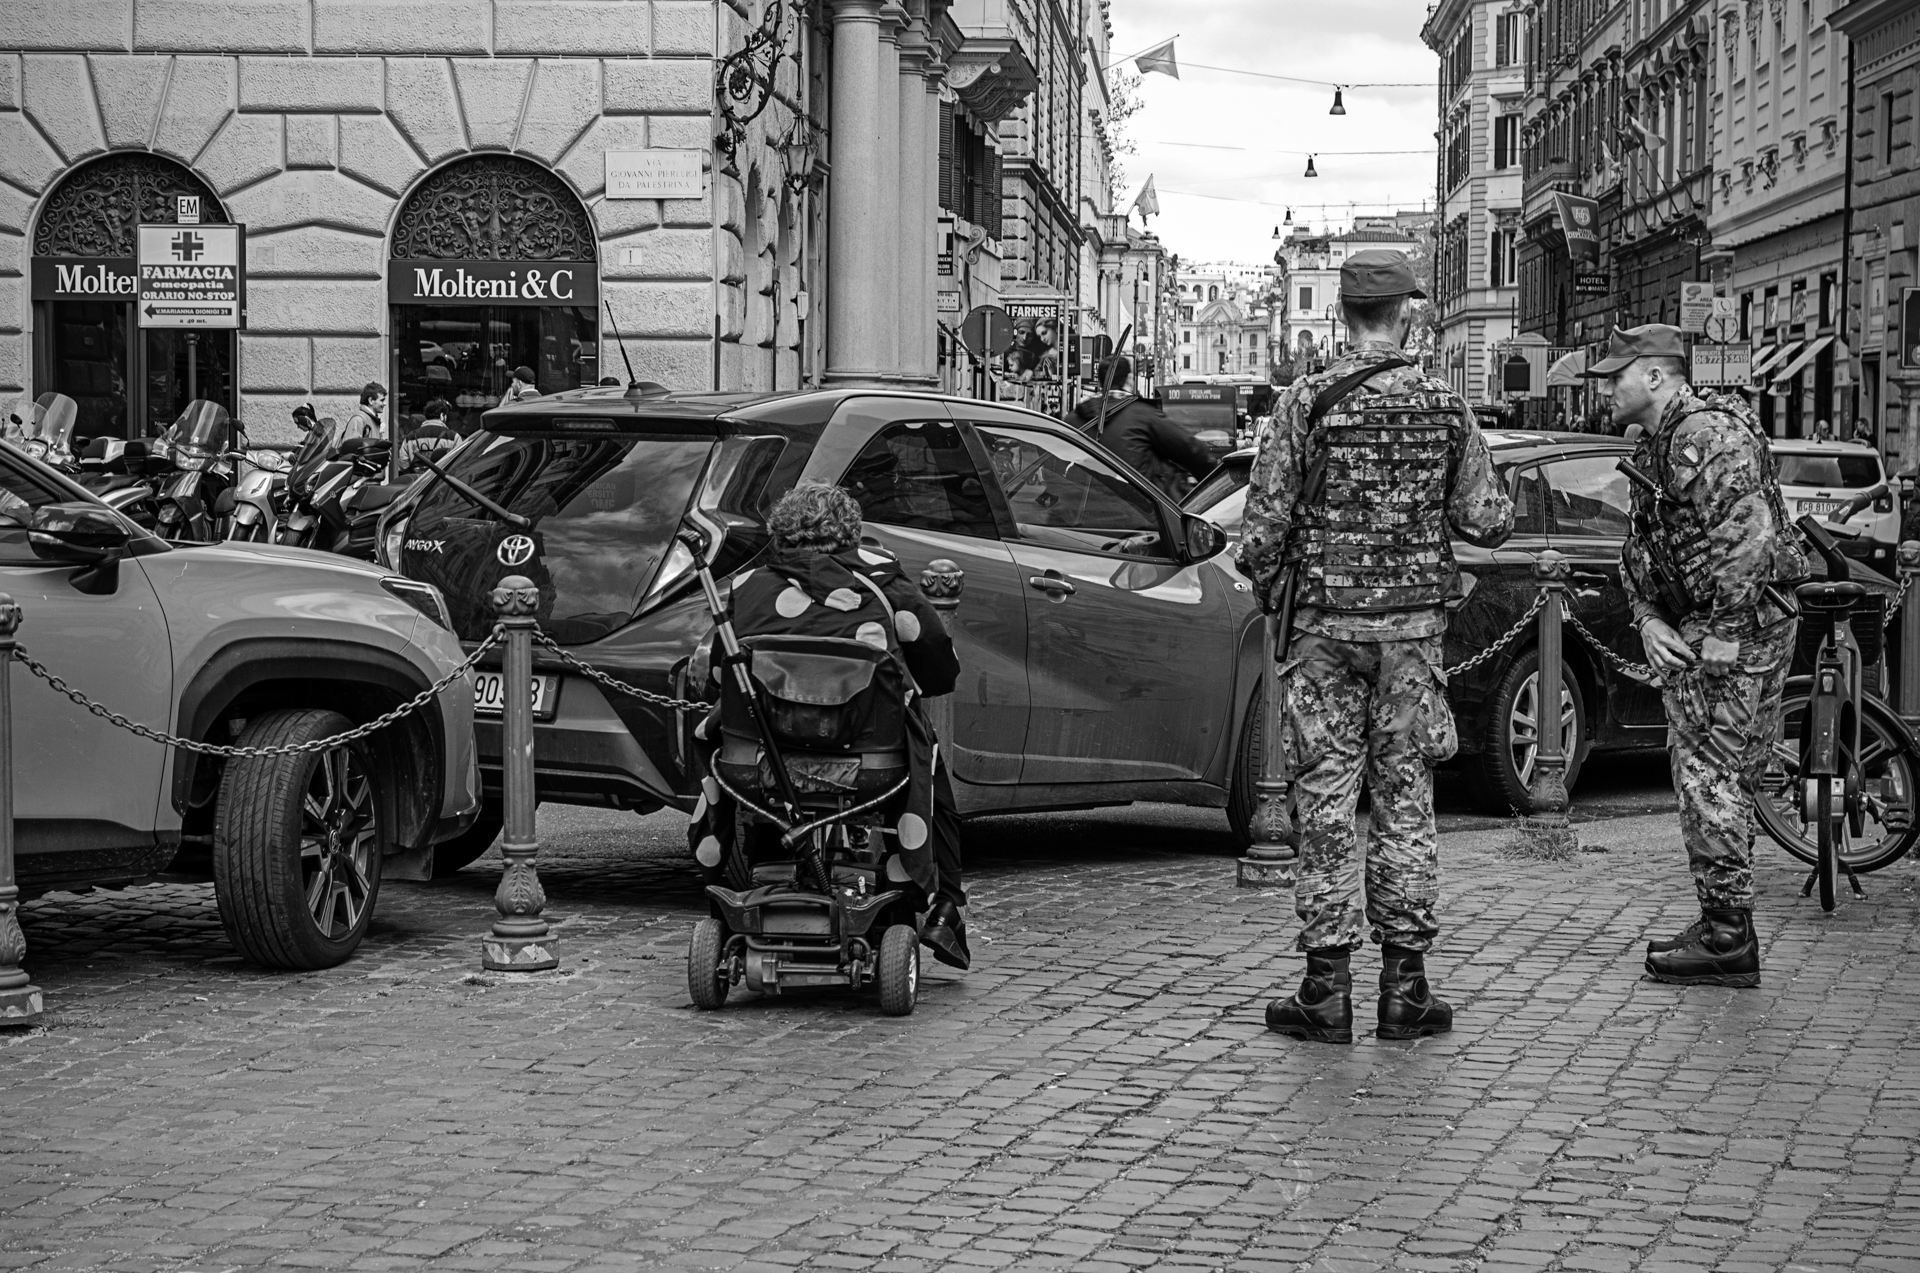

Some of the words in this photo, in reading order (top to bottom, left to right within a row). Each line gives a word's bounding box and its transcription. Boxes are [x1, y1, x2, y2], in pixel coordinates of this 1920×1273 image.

[610, 170, 652, 178] GIOVANNI
[657, 170, 697, 178] PIERLUIGI
[636, 181, 690, 189] PALESTRINA
[179, 199, 198, 214] EM
[142, 266, 234, 279] FARMACIA
[152, 281, 224, 290] omeopatia
[142, 291, 185, 300] ORARIO
[187, 291, 235, 300] NO-STOP
[1012, 306, 1057, 317] FARNESE
[1696, 356, 1706, 364] 06
[1730, 355, 1748, 363] 3419
[1168, 389, 1180, 399] 100
